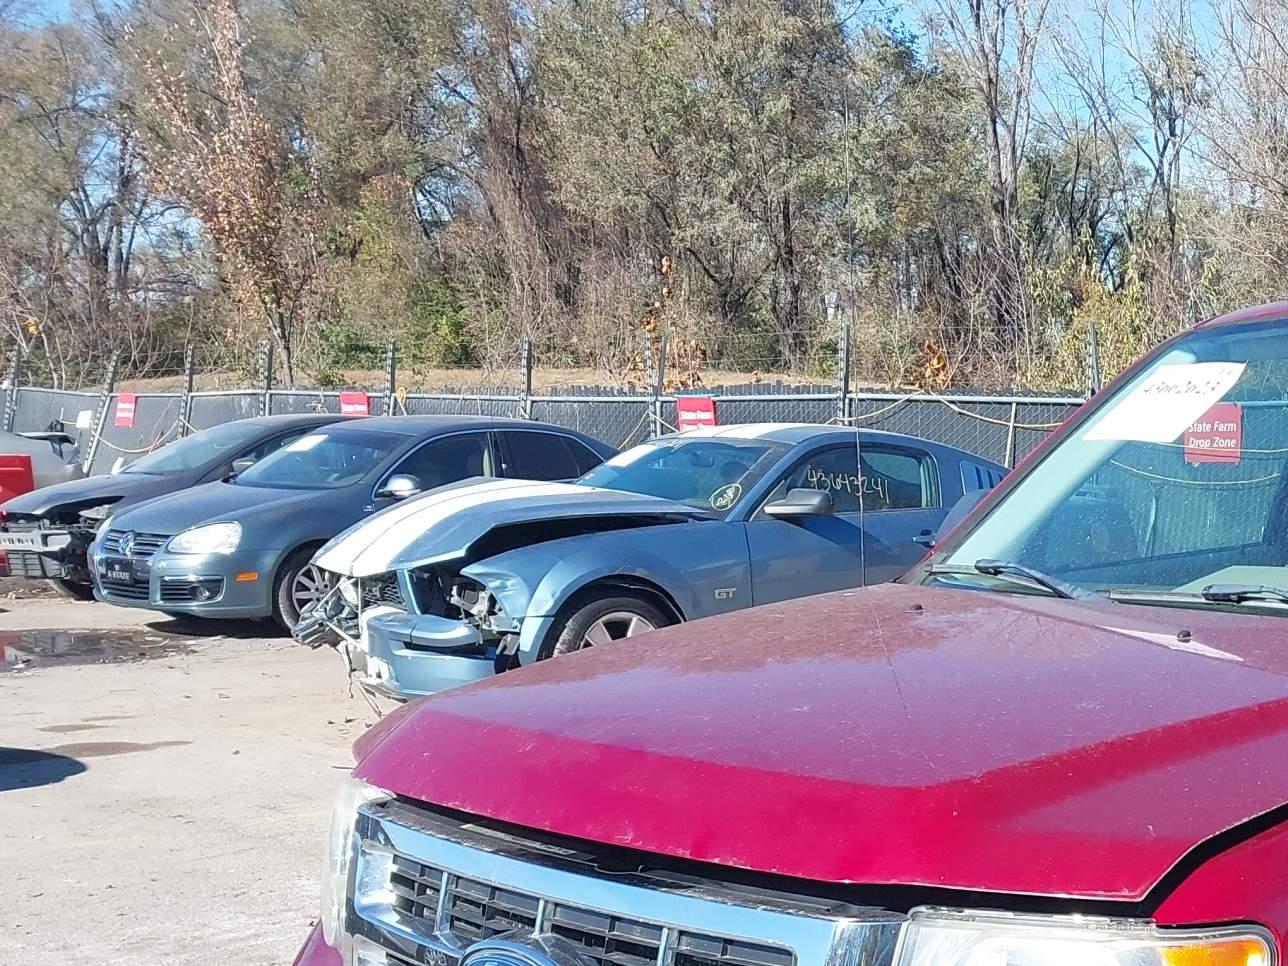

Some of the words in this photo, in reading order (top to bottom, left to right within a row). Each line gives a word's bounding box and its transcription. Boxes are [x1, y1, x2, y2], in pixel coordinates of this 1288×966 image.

[1213, 421, 1236, 432] Farm
[1189, 437, 1211, 449] Drop
[1213, 437, 1236, 448] Zone
[714, 587, 737, 600] GT
